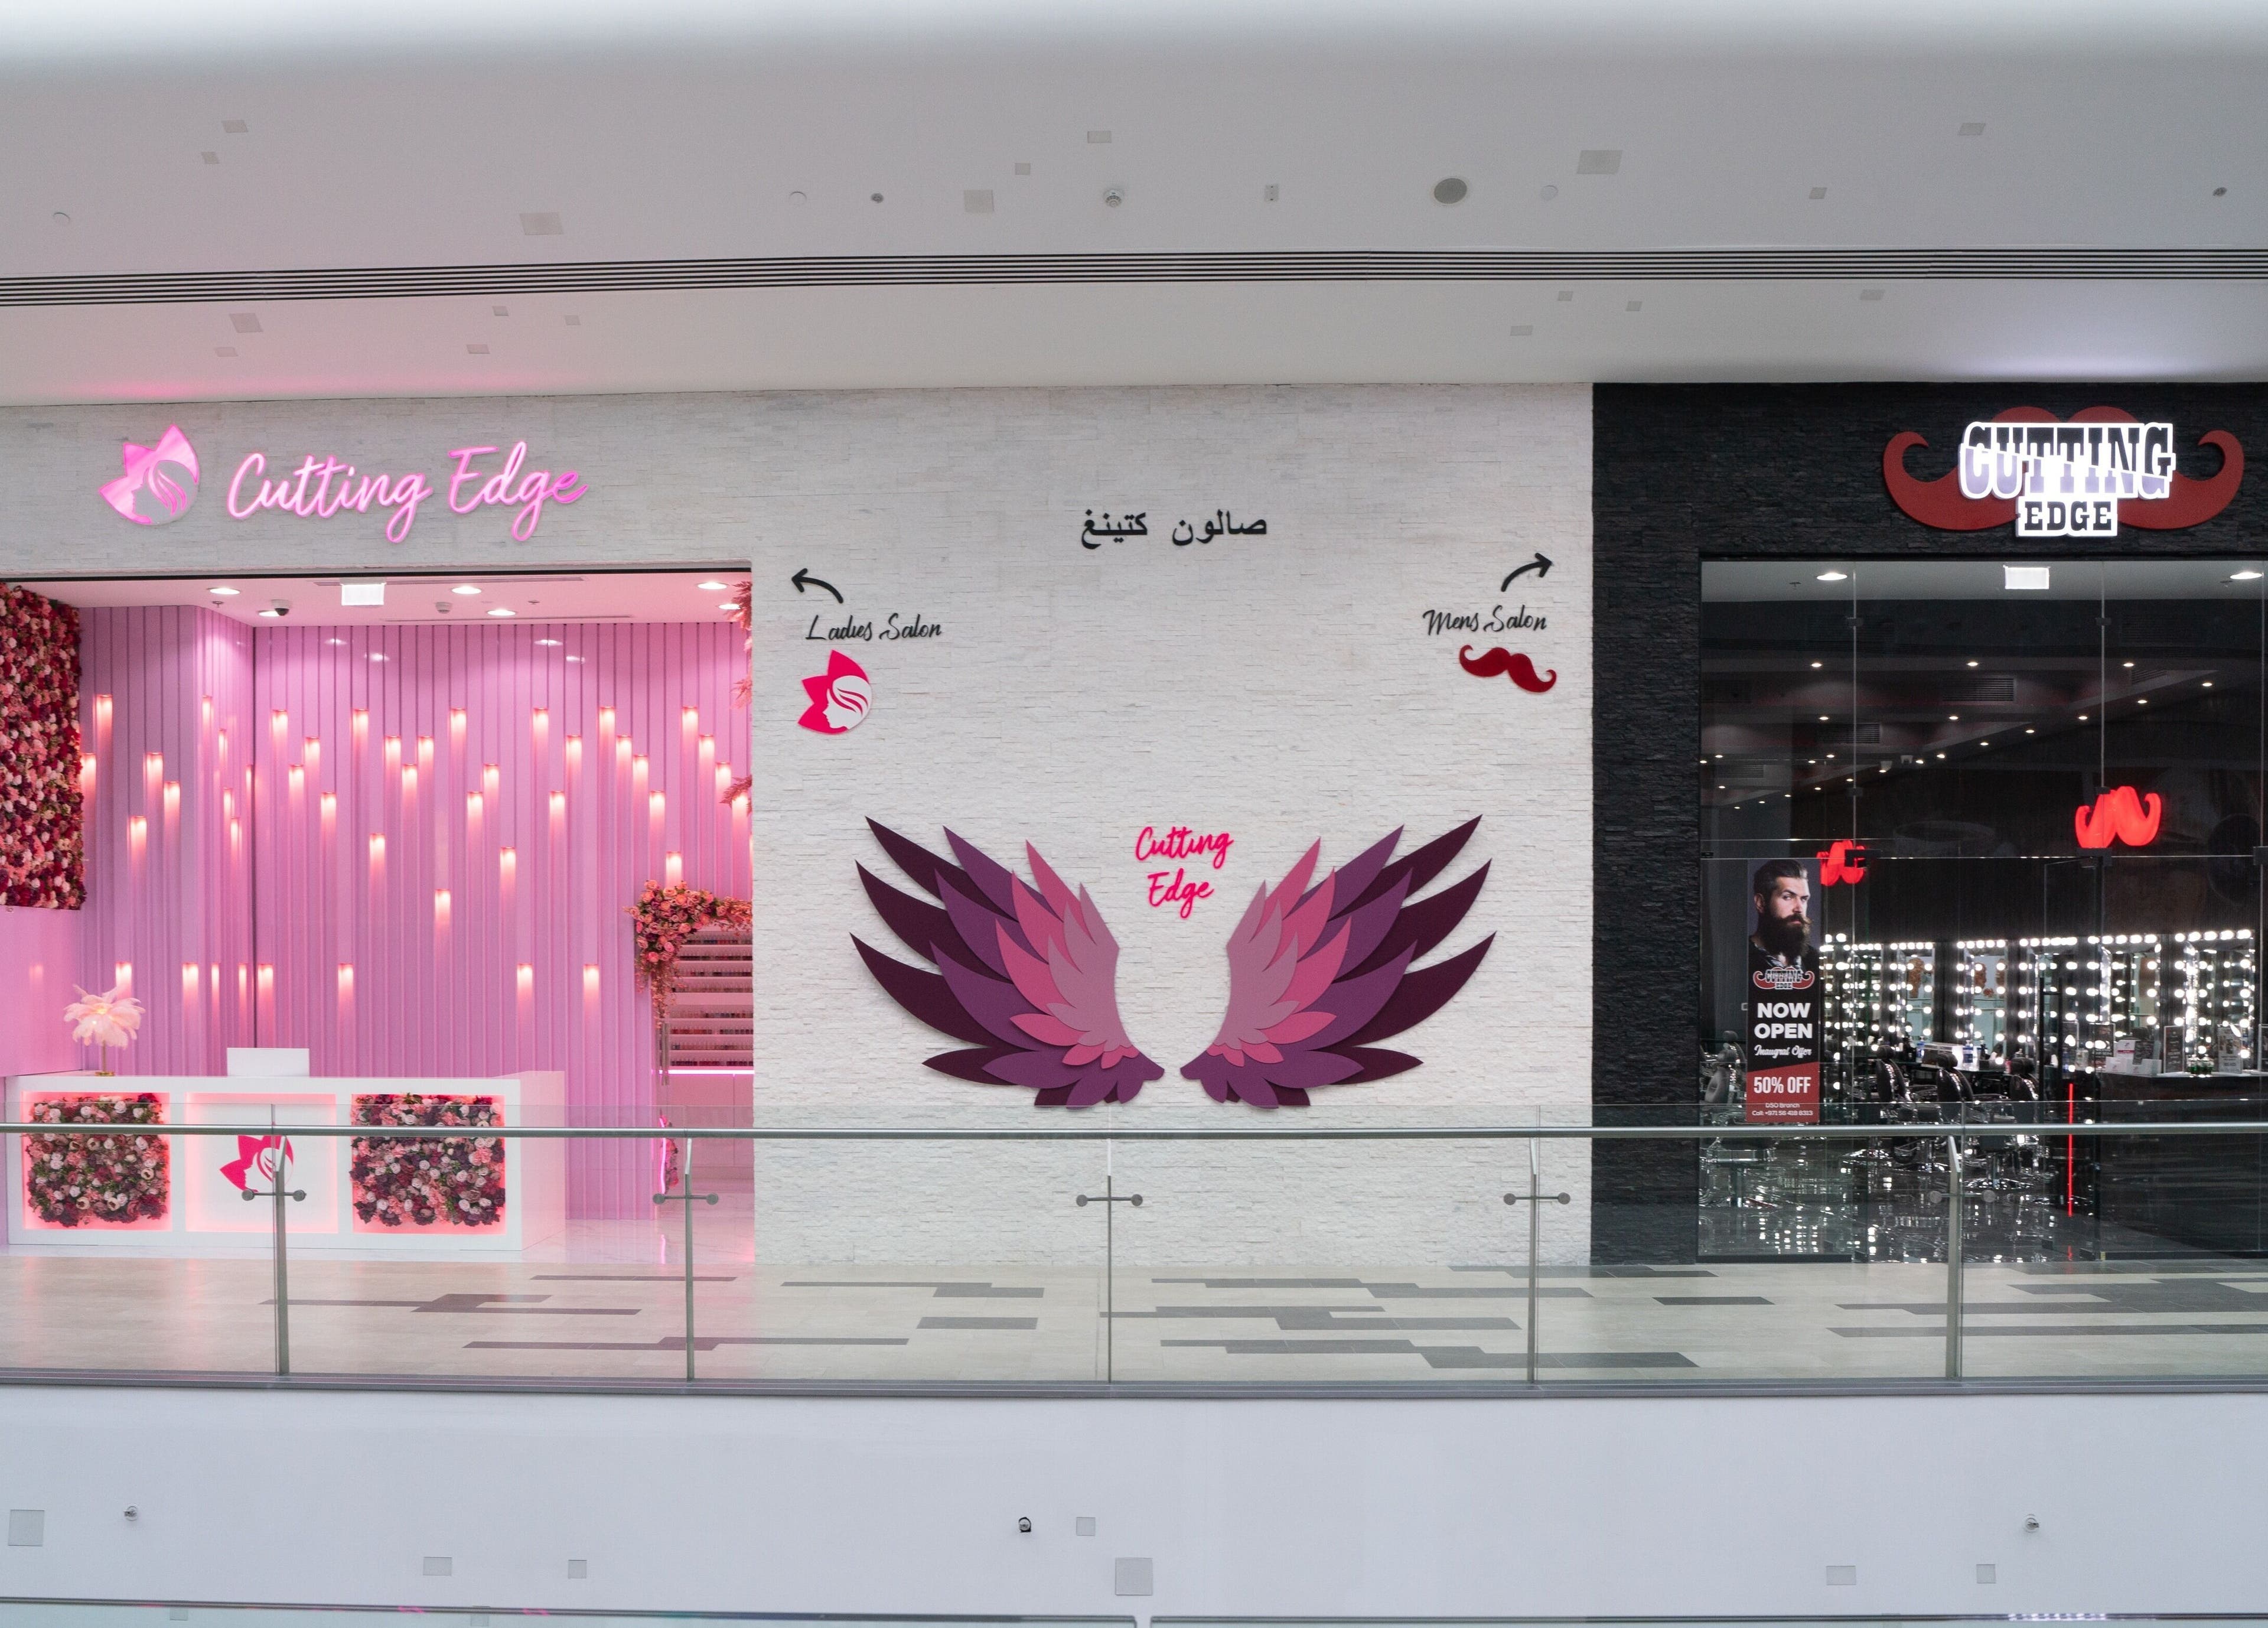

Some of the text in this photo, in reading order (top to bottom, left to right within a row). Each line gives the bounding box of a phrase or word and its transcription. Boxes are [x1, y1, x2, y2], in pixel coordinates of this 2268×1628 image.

[1957, 421, 2176, 500] CUTTING
[227, 441, 589, 543] Cutting Edge
[1081, 509, 1267, 550] صالون كتينغ
[2016, 496, 2117, 537] EDGE
[805, 613, 942, 642] Ladies Salon
[1422, 604, 1547, 636] Mens Salon
[1135, 826, 1234, 870] Cutting
[1147, 867, 1214, 919] Edge
[1775, 982, 1793, 990] EDGE
[1757, 1002, 1811, 1018] NOW
[1754, 1023, 1813, 1039] OPEN
[1791, 1045, 1813, 1059] Offer
[1754, 1076, 1812, 1093] 50% OFF
